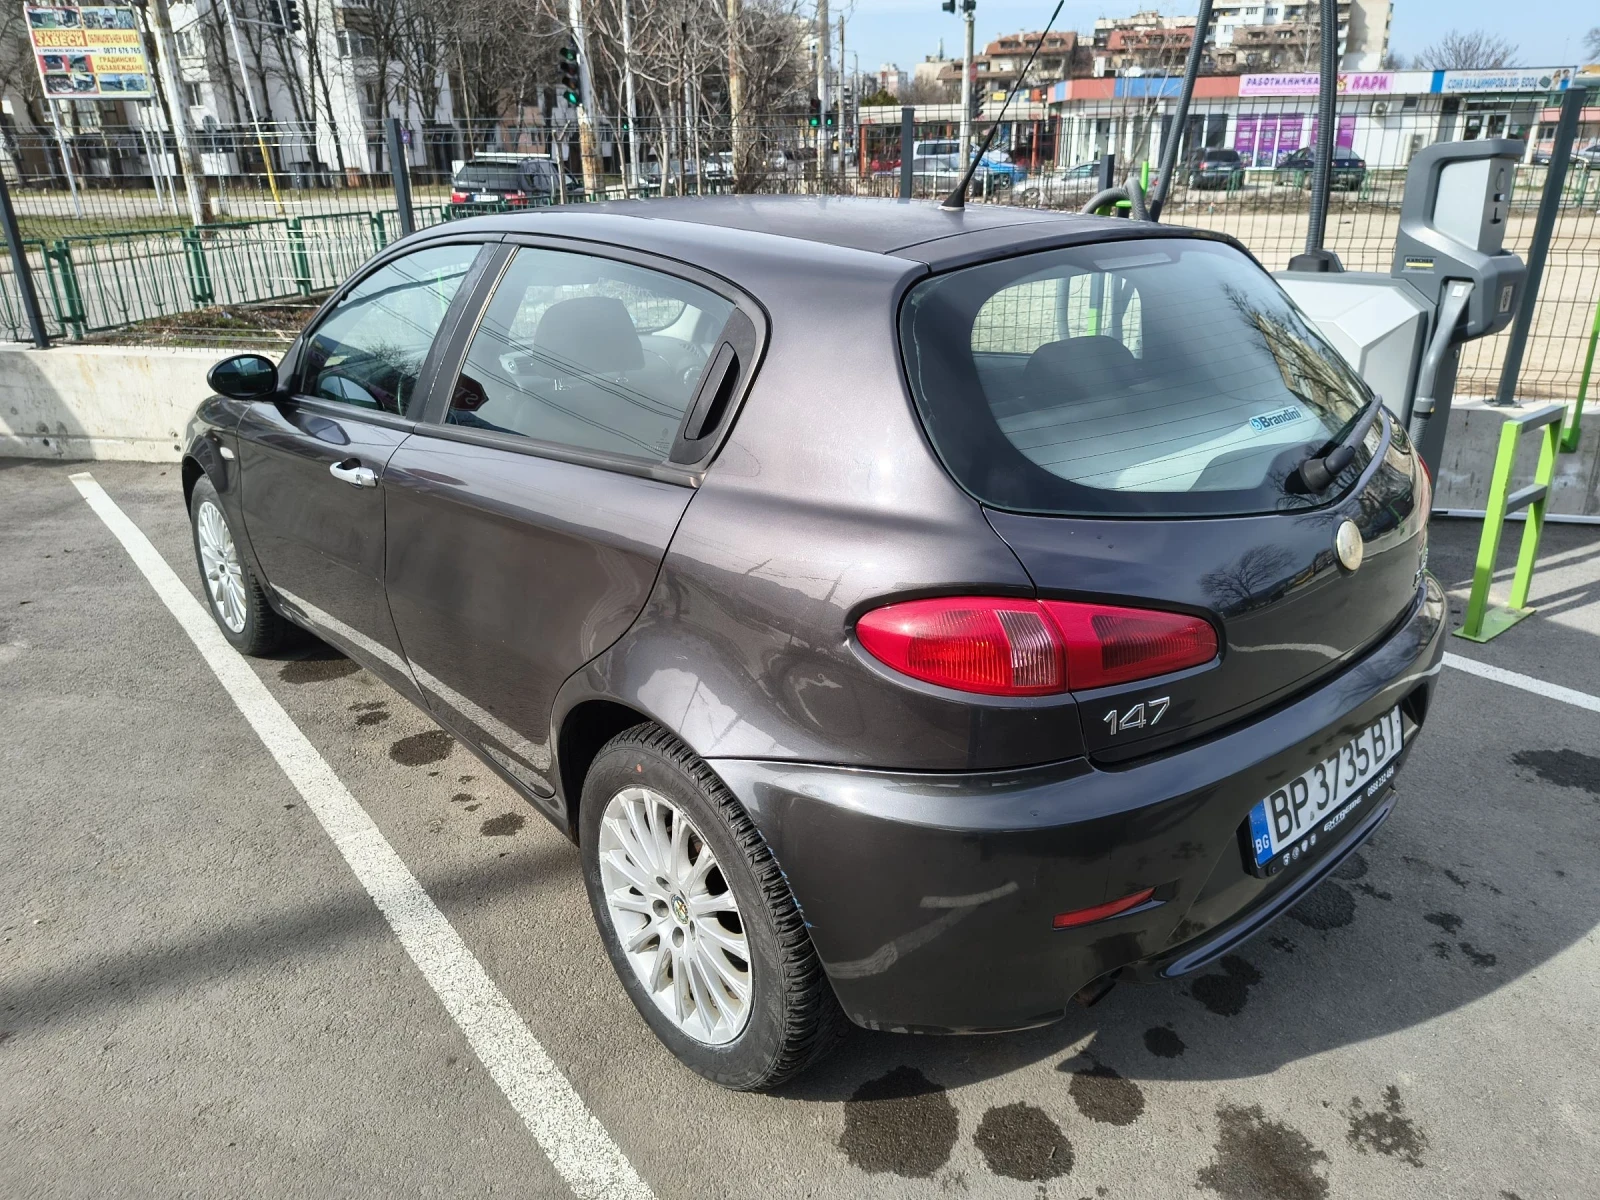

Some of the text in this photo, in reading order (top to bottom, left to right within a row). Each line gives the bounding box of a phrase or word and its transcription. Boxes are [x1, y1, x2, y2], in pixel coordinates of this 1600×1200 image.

[36, 36, 85, 46] ЗАВЕСИ
[99, 56, 137, 64] ГРАДИНСКО
[1352, 75, 1388, 90] КАРИ
[1259, 407, 1302, 429] Brandini
[1103, 696, 1170, 735] 147
[1255, 834, 1270, 855] BG
